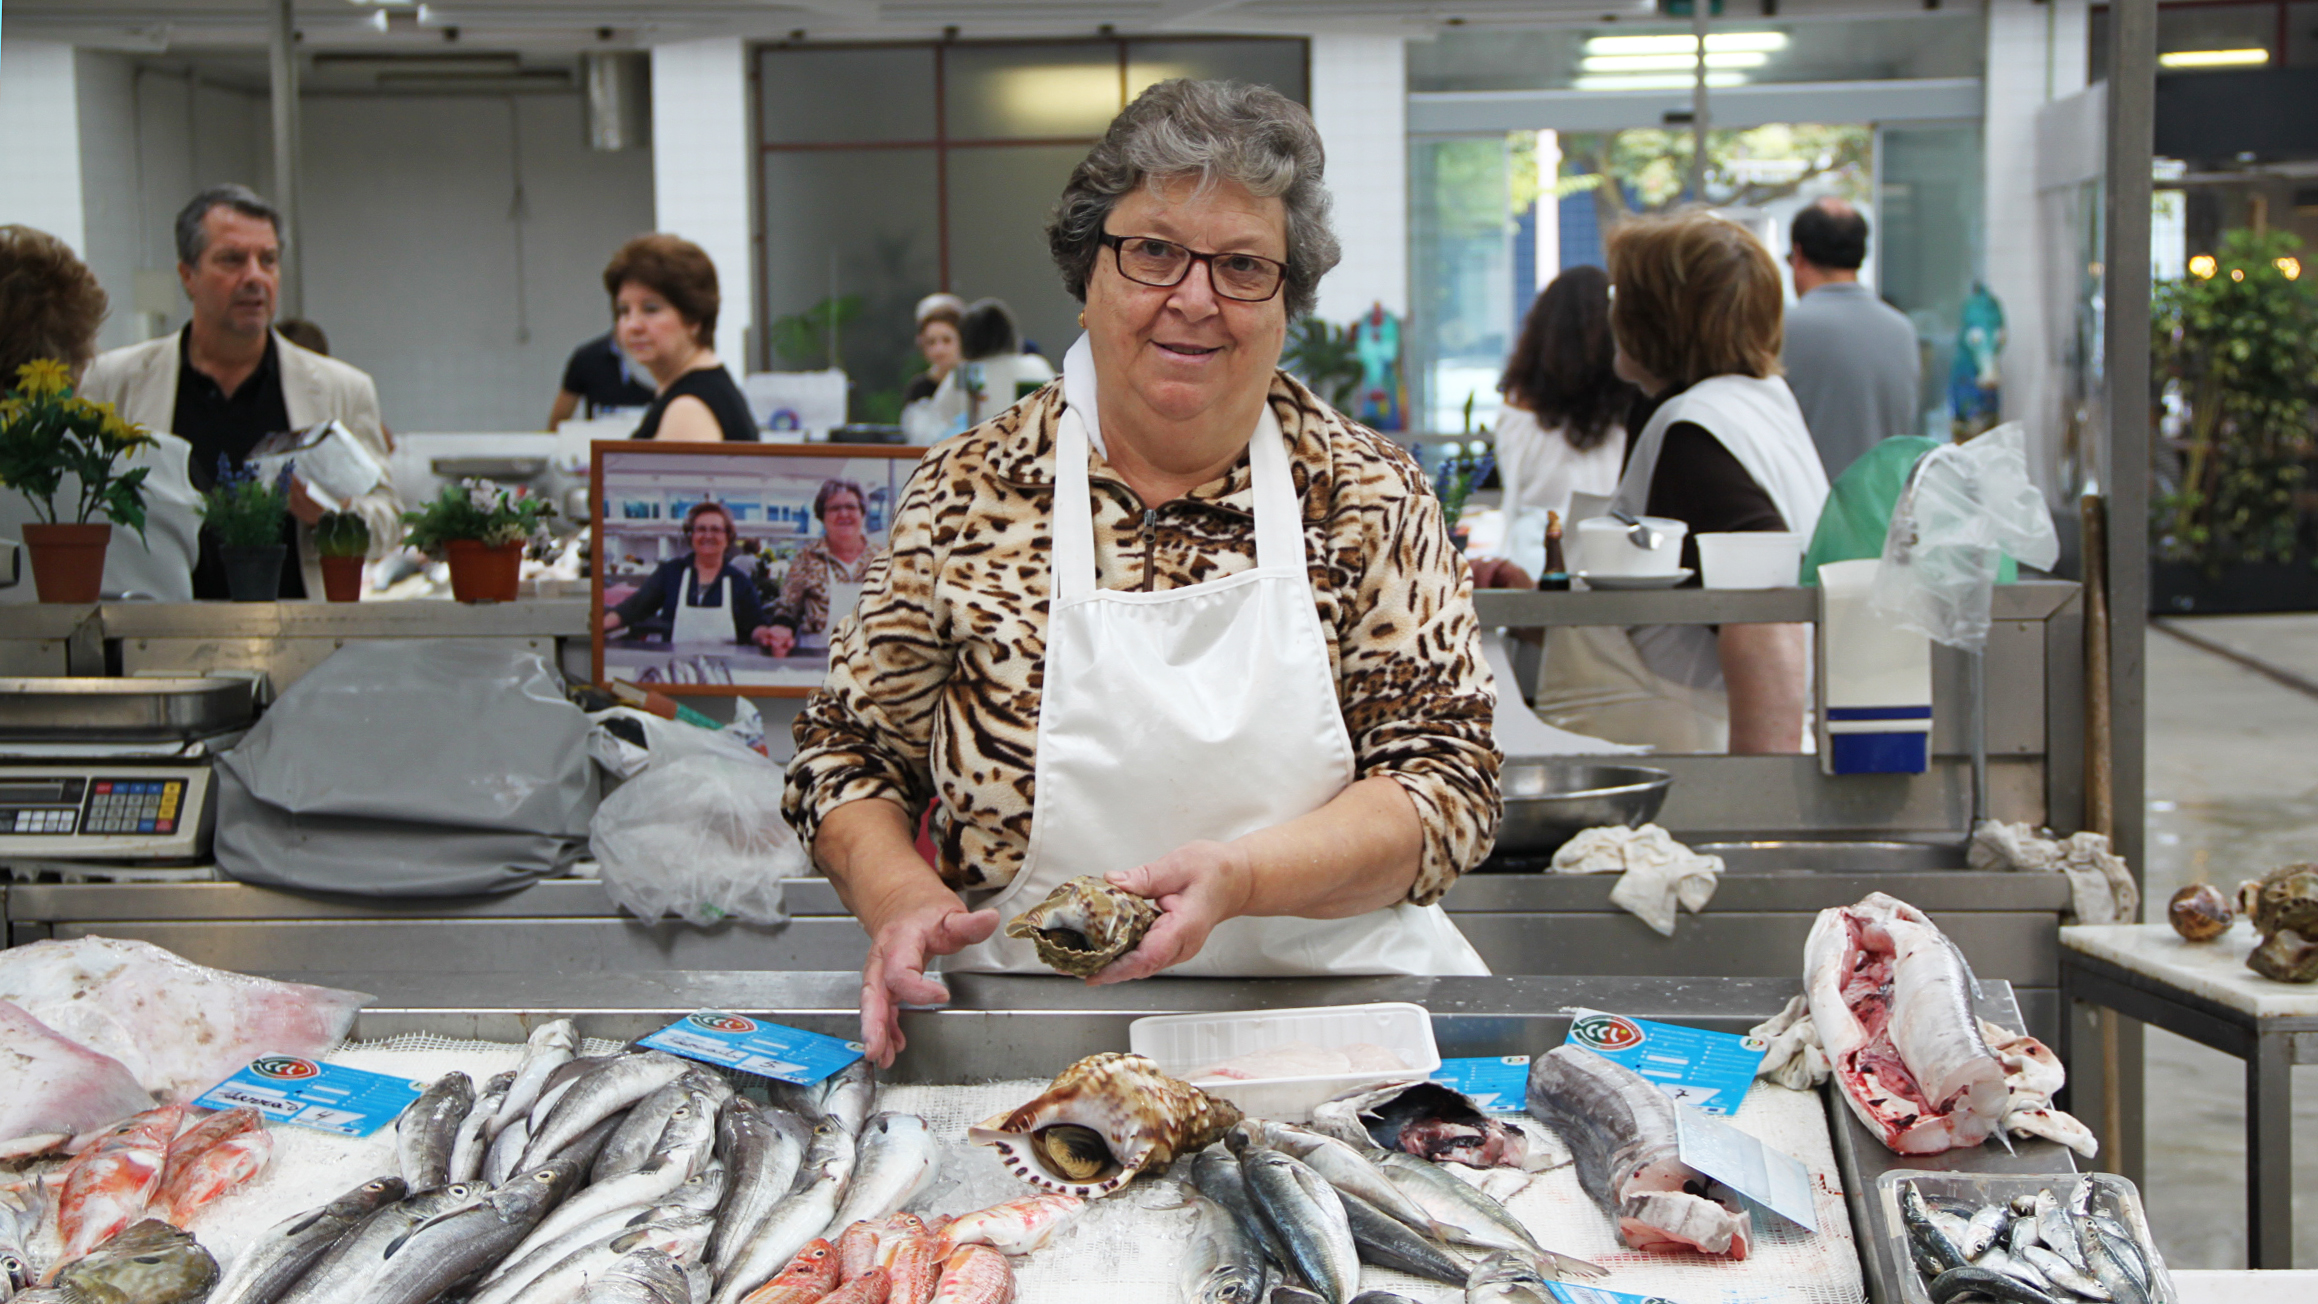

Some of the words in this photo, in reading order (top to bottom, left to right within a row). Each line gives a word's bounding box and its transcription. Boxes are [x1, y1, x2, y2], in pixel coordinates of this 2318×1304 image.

[702, 1016, 735, 1029] CCL
[1585, 1023, 1620, 1043] CCL
[264, 1061, 297, 1075] CCL
